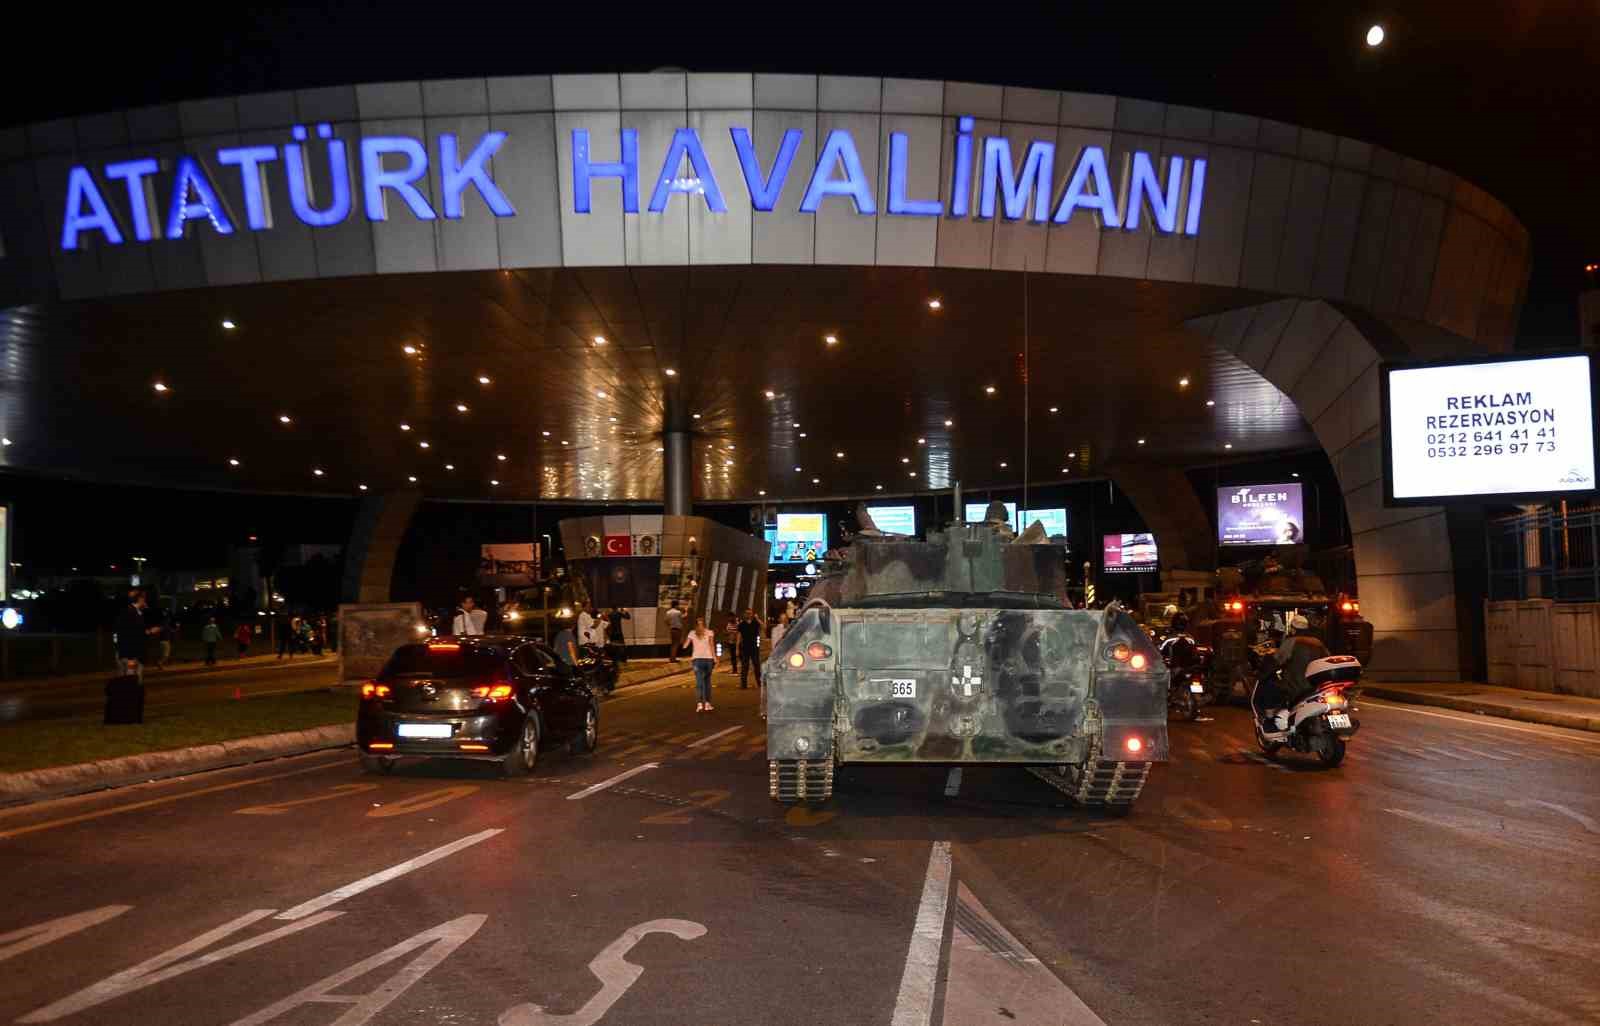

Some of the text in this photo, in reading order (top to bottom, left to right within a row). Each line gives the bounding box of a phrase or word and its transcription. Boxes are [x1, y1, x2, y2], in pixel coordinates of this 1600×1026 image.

[60, 115, 1208, 250] ATATÜRK HAVALİMANI
[1447, 392, 1532, 410] REKLAM
[1426, 409, 1555, 430] REZERVASYON
[1427, 427, 1556, 445] 0212 641 41 41
[1428, 441, 1556, 458] 0532 296 97 73
